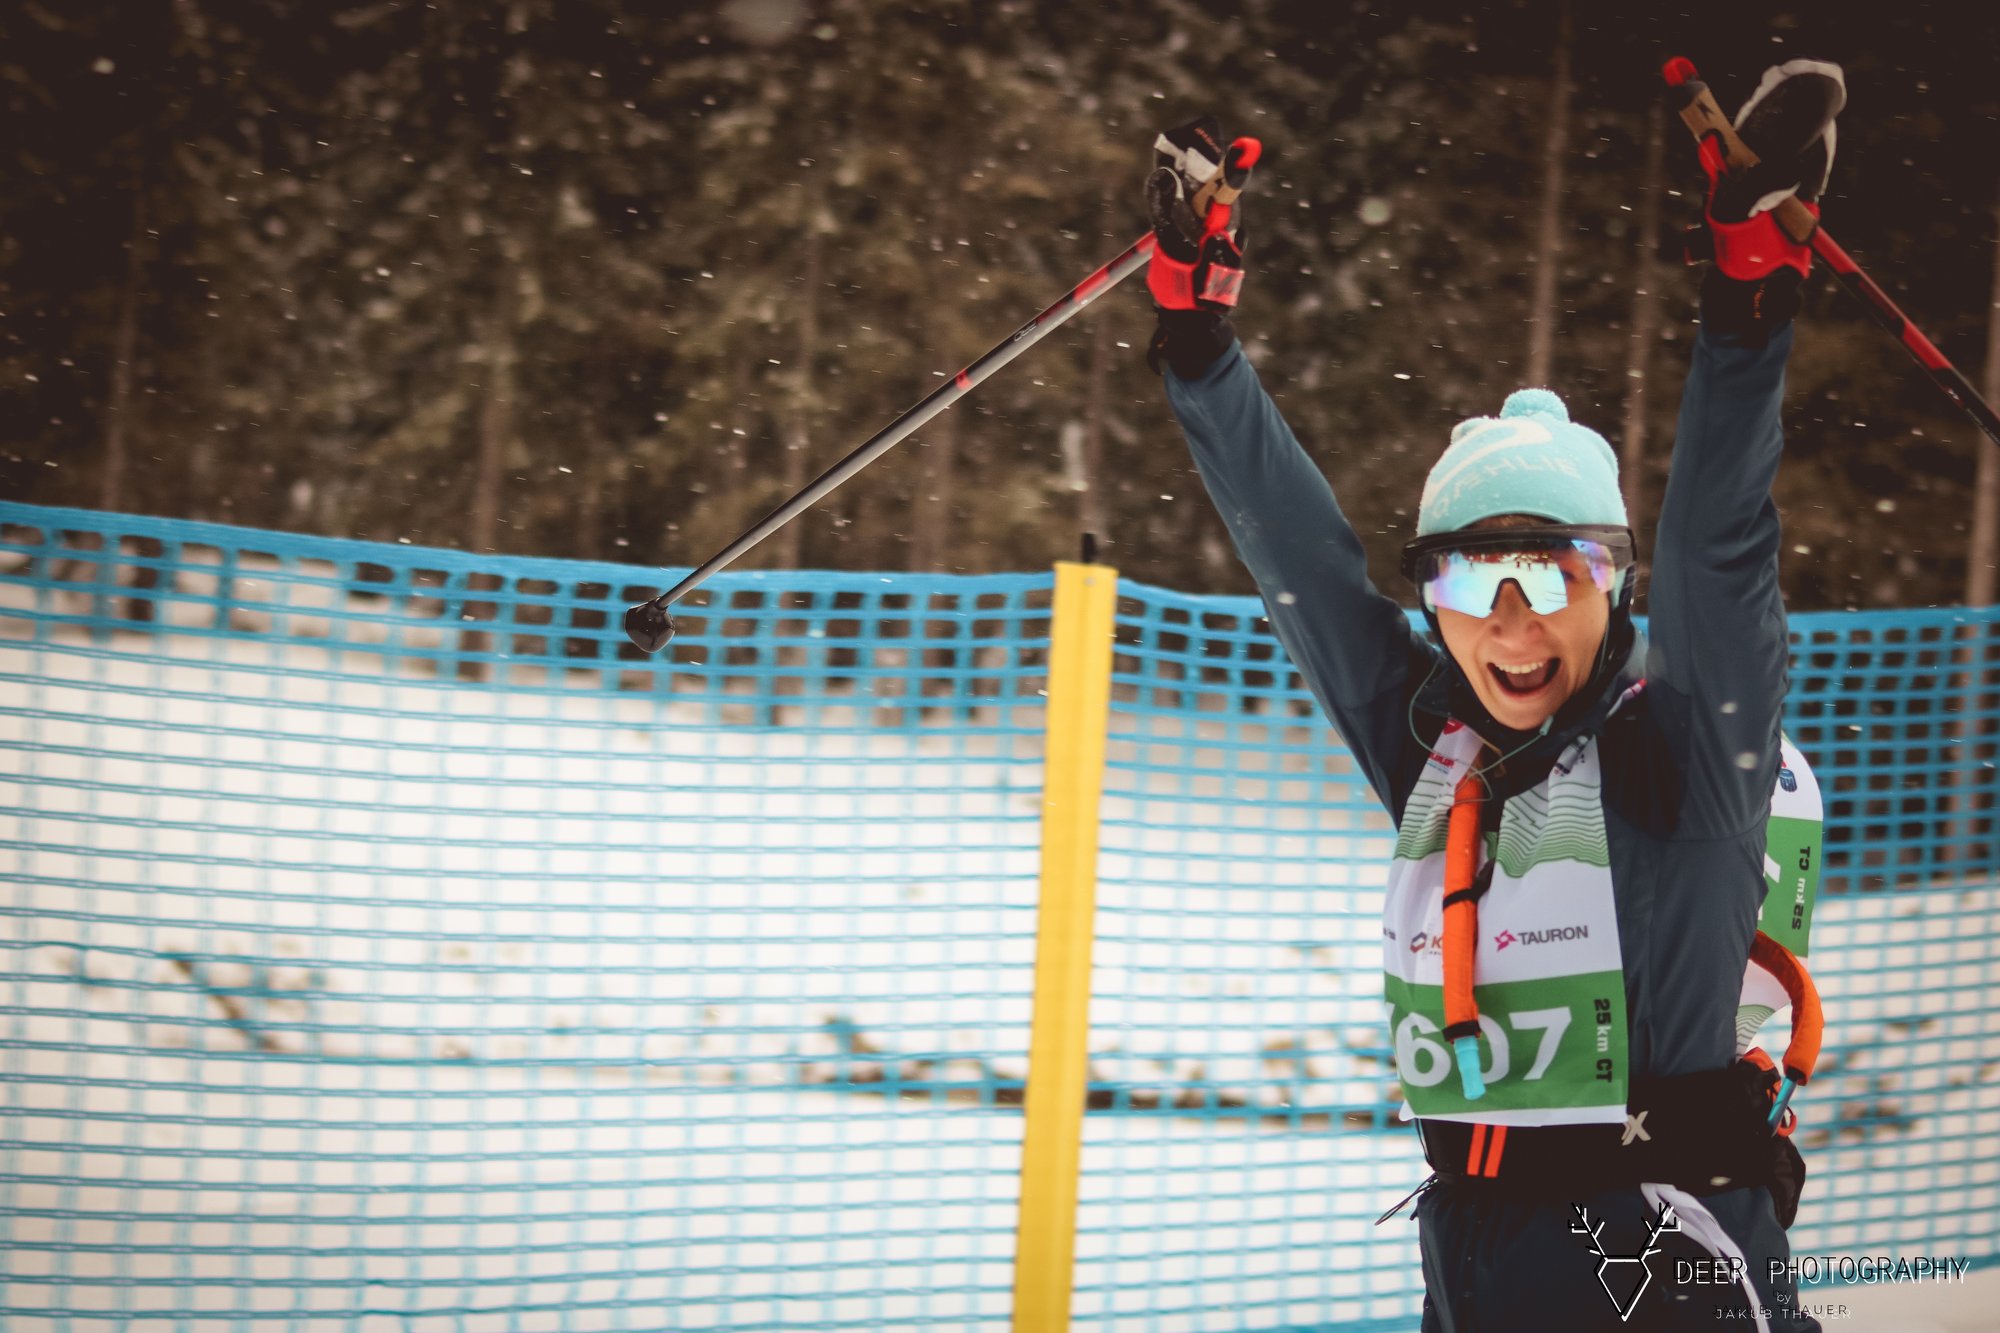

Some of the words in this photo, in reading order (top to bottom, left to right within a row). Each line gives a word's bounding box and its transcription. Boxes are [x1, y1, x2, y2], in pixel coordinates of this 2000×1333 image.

[1517, 925, 1589, 946] TAURON
[1386, 1003, 1573, 1088] 607
[1594, 998, 1612, 1053] 25km
[1596, 1058, 1613, 1083] CT
